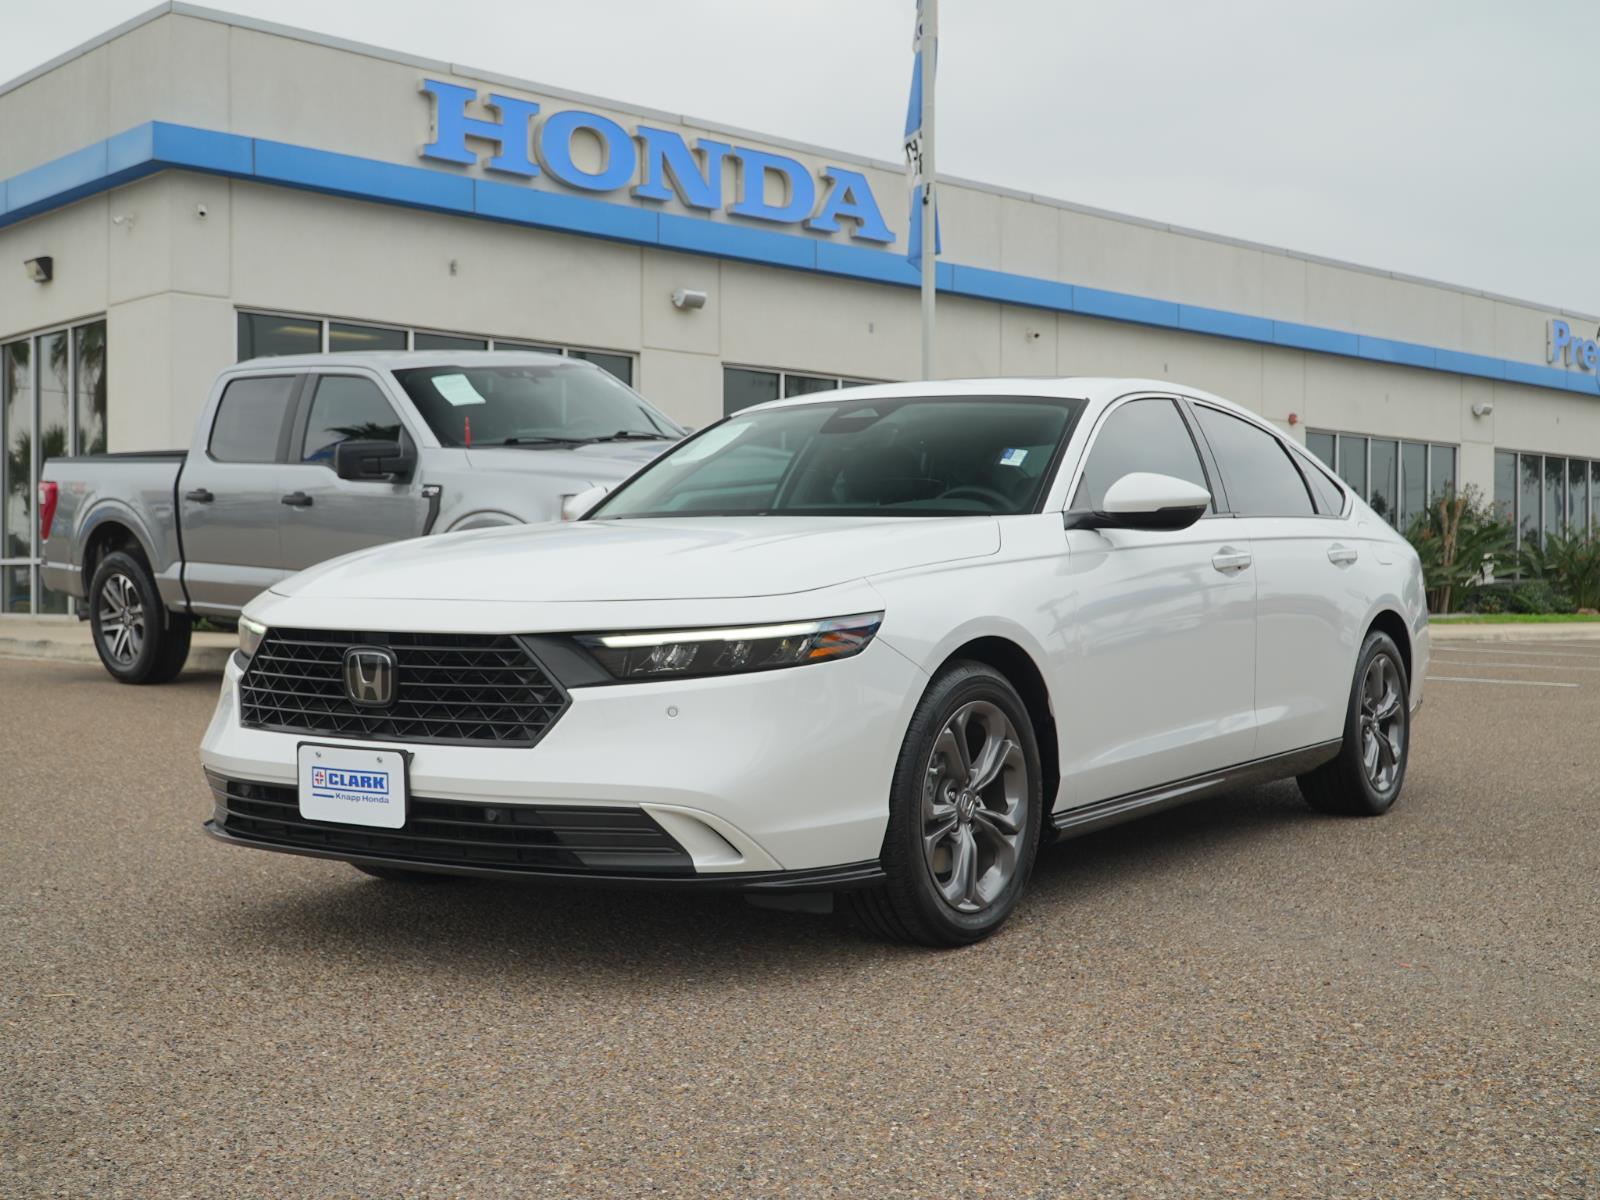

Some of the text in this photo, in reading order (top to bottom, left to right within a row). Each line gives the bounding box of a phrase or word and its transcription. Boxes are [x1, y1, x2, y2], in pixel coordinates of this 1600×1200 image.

[419, 78, 896, 243] HONDA
[328, 773, 385, 789] CLARK
[335, 792, 390, 804] Knapp Honda
